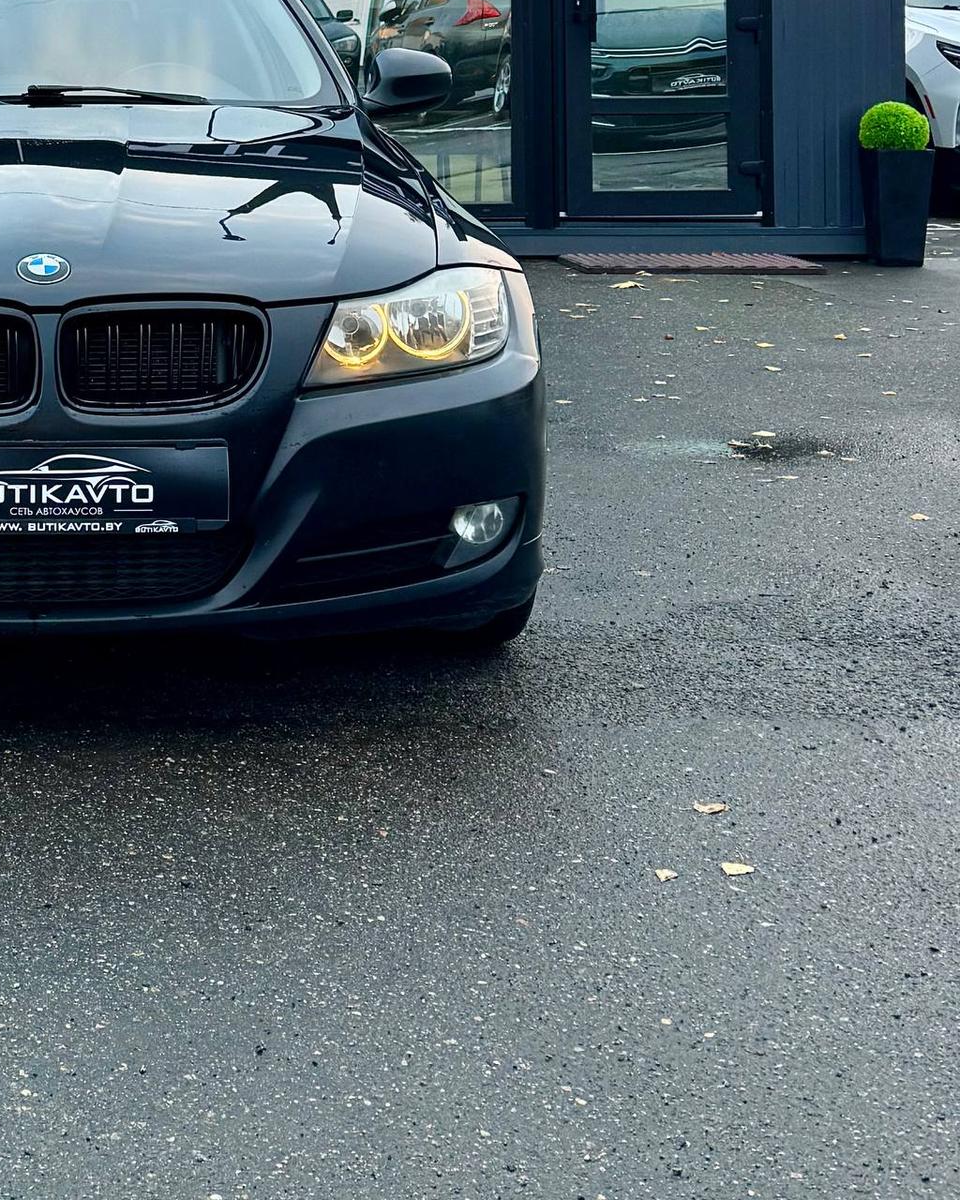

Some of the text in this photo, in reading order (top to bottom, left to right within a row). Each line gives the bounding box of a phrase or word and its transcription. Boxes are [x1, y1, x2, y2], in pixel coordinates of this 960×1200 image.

[9, 505, 104, 517] СЕТЬ АВТОХАУСОВ
[27, 521, 123, 532] BUTIKAVTO.BY
